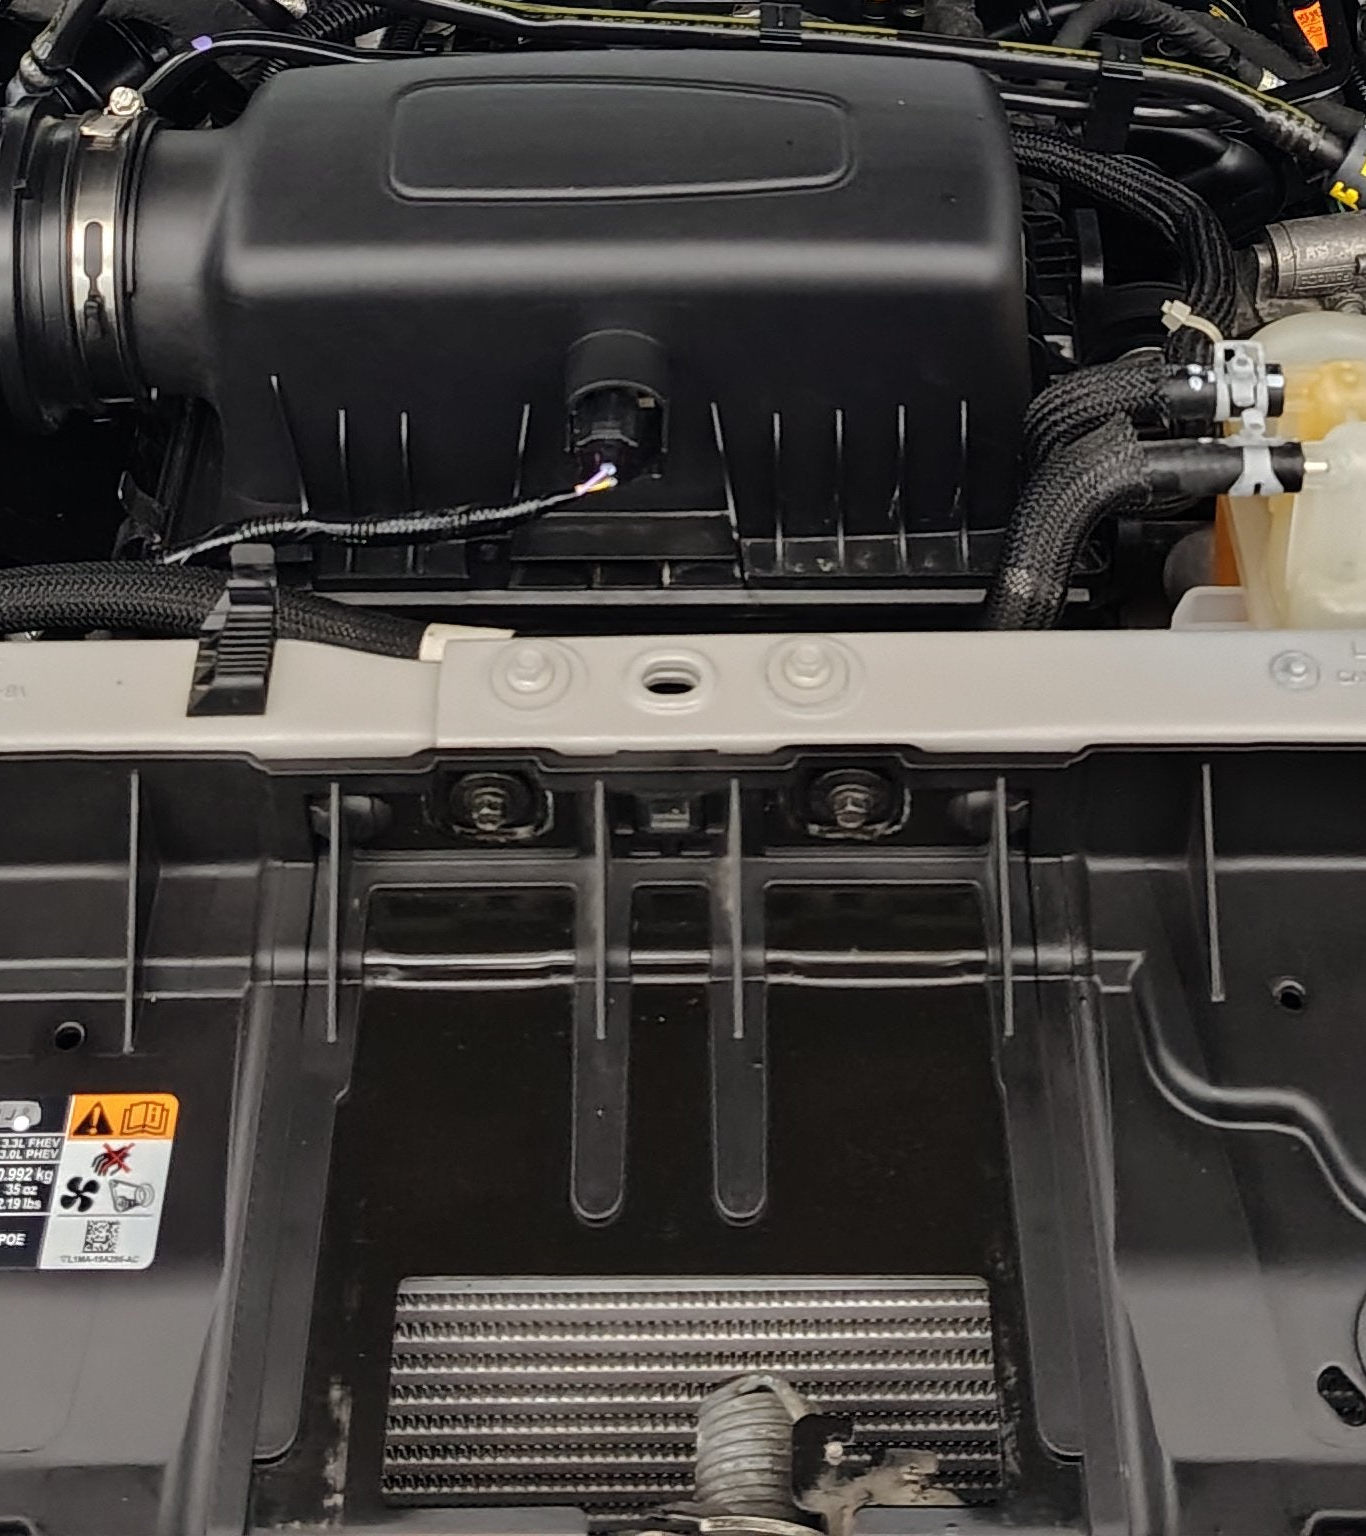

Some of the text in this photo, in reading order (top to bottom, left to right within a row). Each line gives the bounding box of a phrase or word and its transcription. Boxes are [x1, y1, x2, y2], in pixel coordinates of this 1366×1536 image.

[0, 1138, 61, 1148] 3.3L FHEV
[26, 1149, 59, 1159] PHEV
[36, 1167, 53, 1184] kg
[5, 1184, 38, 1195] 35 oz
[22, 1198, 41, 1209] lbs
